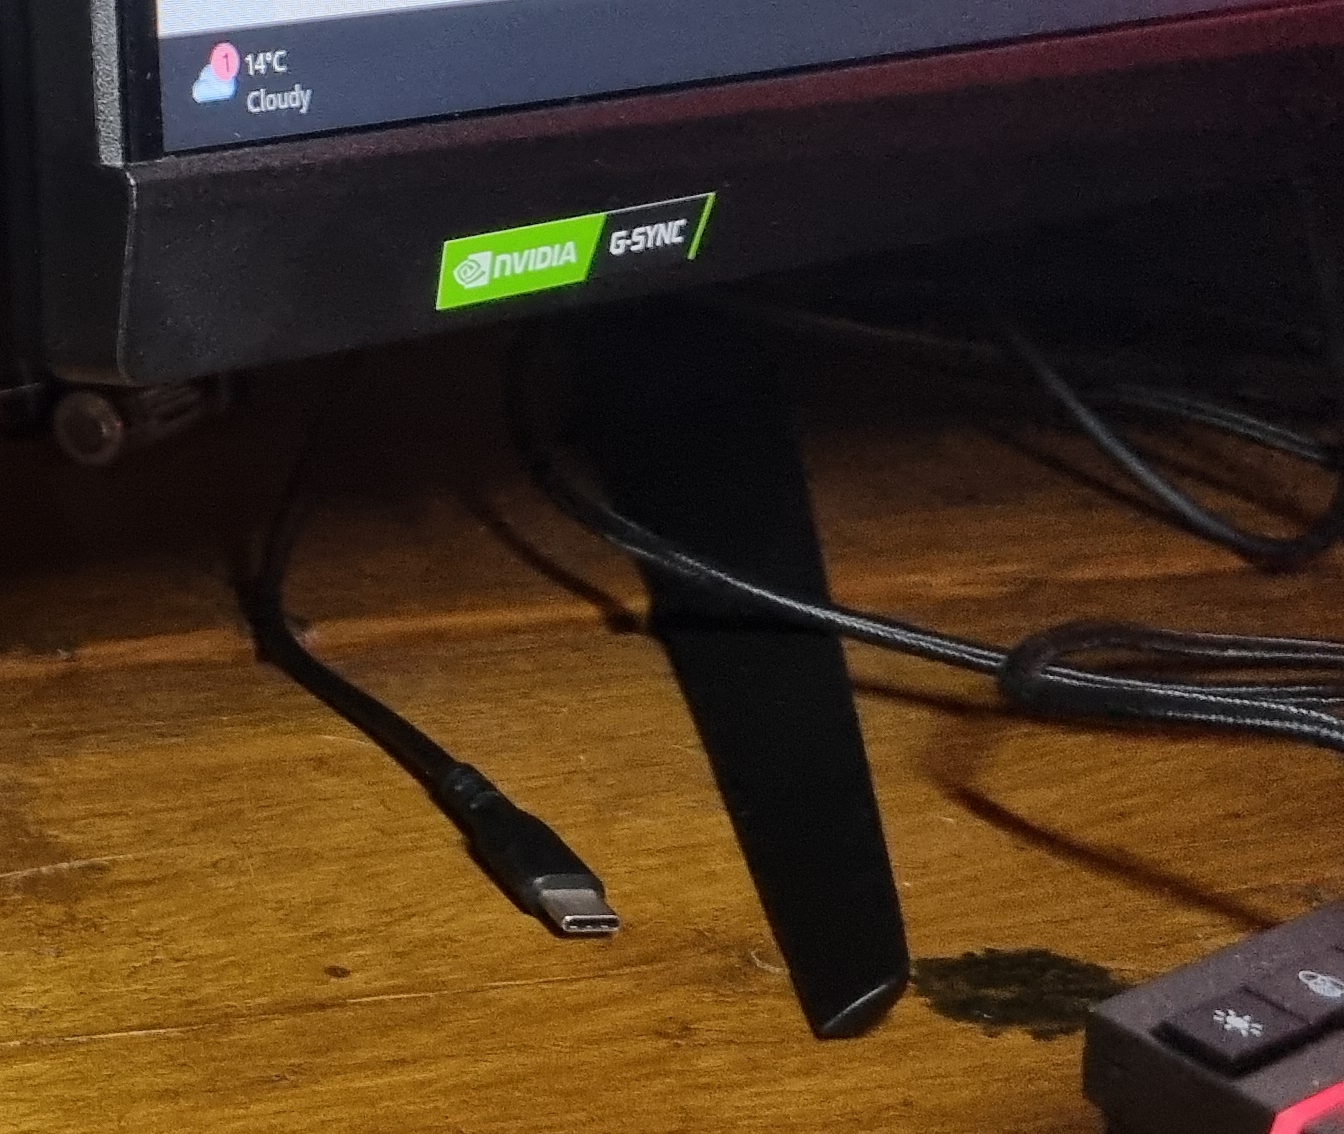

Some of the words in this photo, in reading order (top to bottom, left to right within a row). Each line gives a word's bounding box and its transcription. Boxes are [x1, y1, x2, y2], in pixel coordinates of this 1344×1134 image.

[244, 49, 288, 76] 14°C
[246, 84, 313, 114] Cloudy
[493, 241, 578, 278] NVIDIA
[609, 218, 689, 256] G-SYNC
